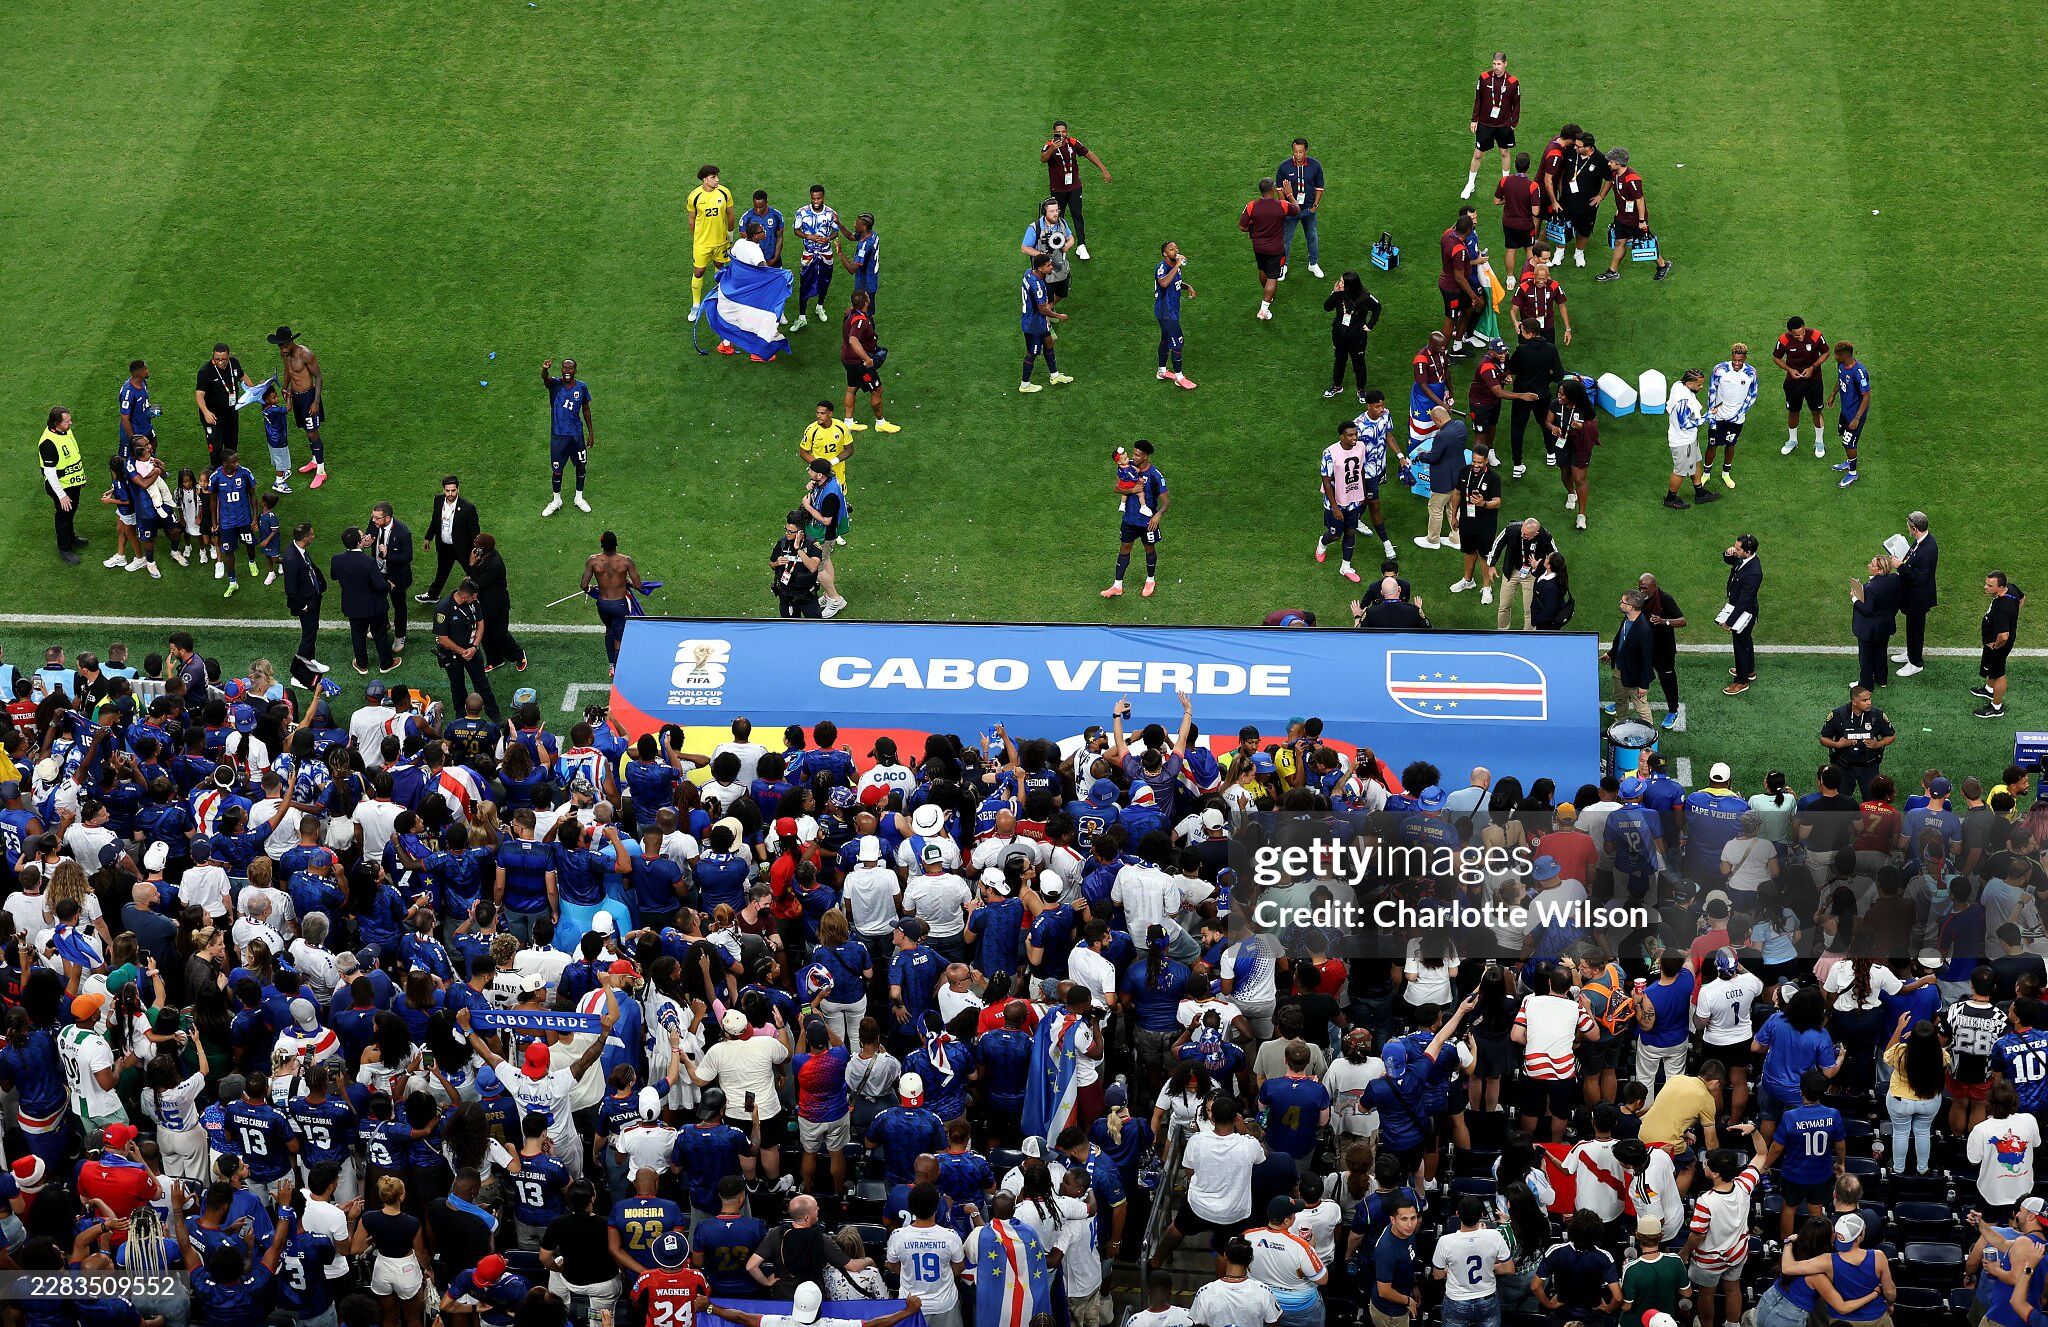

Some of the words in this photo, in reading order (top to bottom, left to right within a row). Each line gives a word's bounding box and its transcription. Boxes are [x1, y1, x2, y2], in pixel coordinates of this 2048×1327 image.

[705, 207, 719, 218] 23
[305, 416, 313, 428] 3
[824, 443, 837, 454] 12
[226, 491, 240, 503] 10
[240, 532, 253, 545] 10
[819, 656, 1030, 692] CABO
[1046, 658, 1293, 697] VERDE
[667, 696, 722, 706] 2026
[9, 712, 37, 721] ONTEIRO
[873, 771, 907, 783] CACO
[1025, 779, 1049, 788] EEDOM
[1690, 804, 1708, 818] CAPE
[1709, 810, 1737, 821] VERDE
[1863, 803, 1877, 811] CABO
[1405, 823, 1422, 832] CABO
[1423, 827, 1444, 836] VERDE
[1868, 814, 1882, 833] 7
[1927, 817, 1945, 829] SMITH
[1623, 831, 1642, 854] 12
[491, 983, 517, 994] IDANE
[1725, 988, 1744, 1000] COTA
[1730, 1001, 1741, 1026] 1
[485, 1014, 528, 1027] CABO
[536, 1015, 589, 1029] VERDE
[1956, 1027, 1994, 1057] 28
[2004, 1038, 2048, 1056] FORTES
[2012, 1052, 2048, 1084] 10
[271, 1088, 288, 1097] OPES
[233, 1115, 249, 1125] LOPES
[249, 1117, 270, 1129] CABRAL
[311, 1116, 333, 1126] CABRAL
[485, 1111, 506, 1122] OPES
[1281, 1104, 1301, 1132] 4
[1796, 1118, 1824, 1130] NEYMAR
[1824, 1116, 1834, 1128] JR
[239, 1126, 268, 1156] 13
[303, 1124, 331, 1150] 13
[1802, 1130, 1829, 1156] 10
[525, 1170, 547, 1182] CABRAL
[515, 1180, 545, 1208] 13
[623, 1207, 665, 1219] MOREIRA
[625, 1220, 664, 1251] 23
[903, 1241, 947, 1250] LIVRAMENTO
[911, 1252, 941, 1284] 19
[1464, 1254, 1484, 1285] 2
[655, 1287, 691, 1297] WAGNER
[653, 1299, 693, 1327] 24
